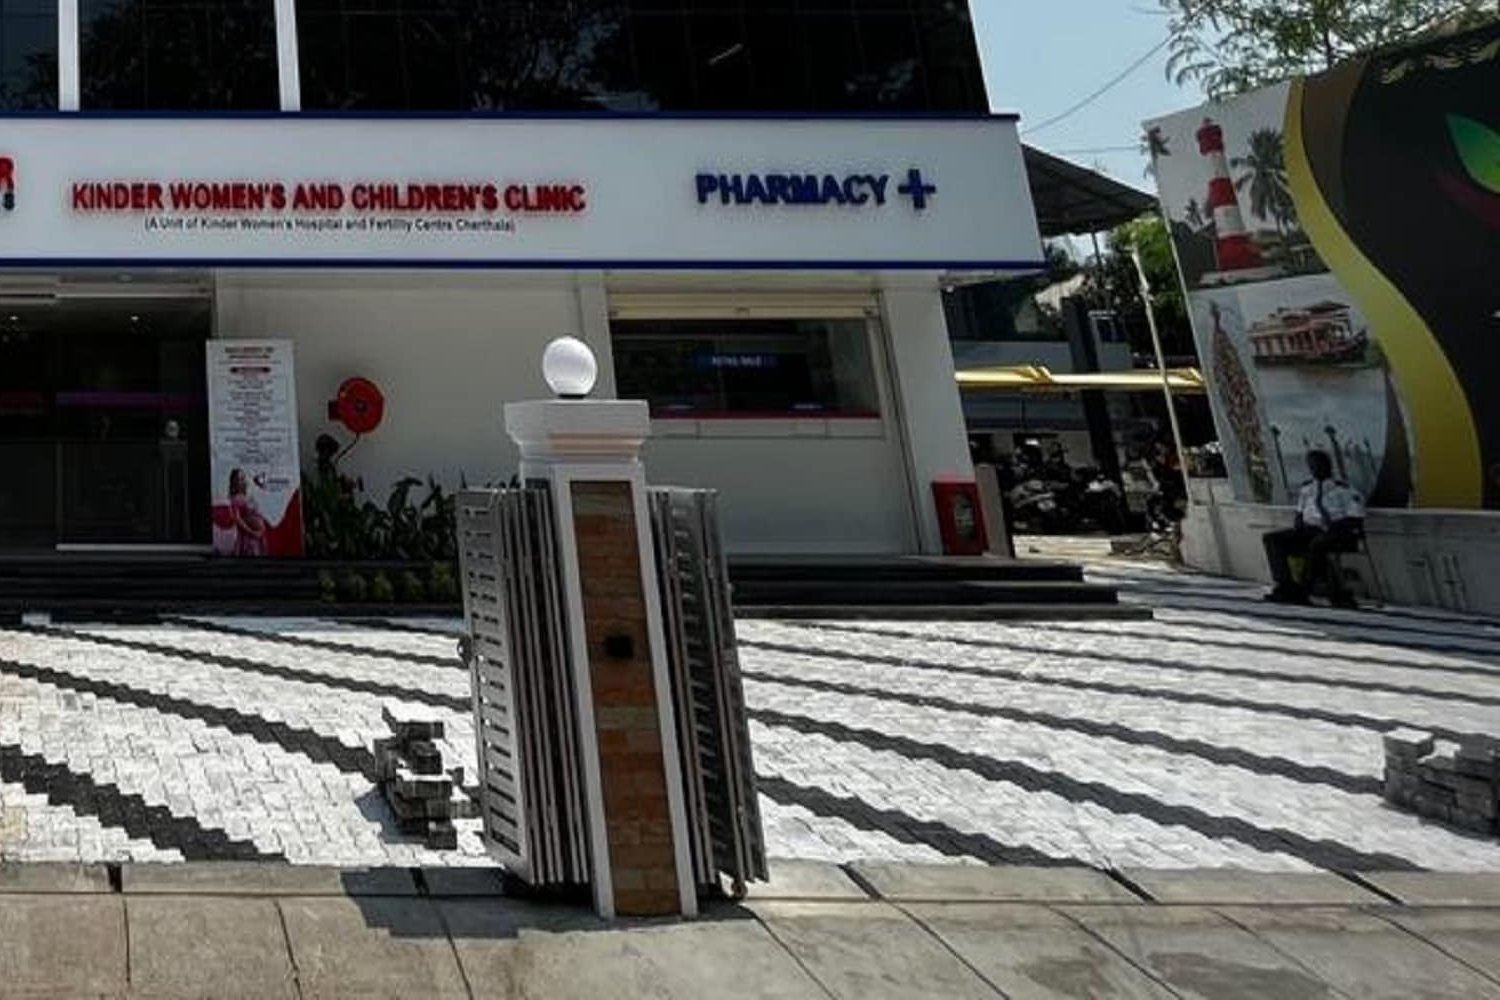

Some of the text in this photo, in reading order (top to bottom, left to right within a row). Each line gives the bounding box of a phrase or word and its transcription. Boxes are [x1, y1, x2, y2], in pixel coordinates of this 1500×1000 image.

[72, 183, 586, 212] KINDER WOMEN'S AND CHILDREN'S CLINIC
[695, 173, 889, 206] PHARMACY
